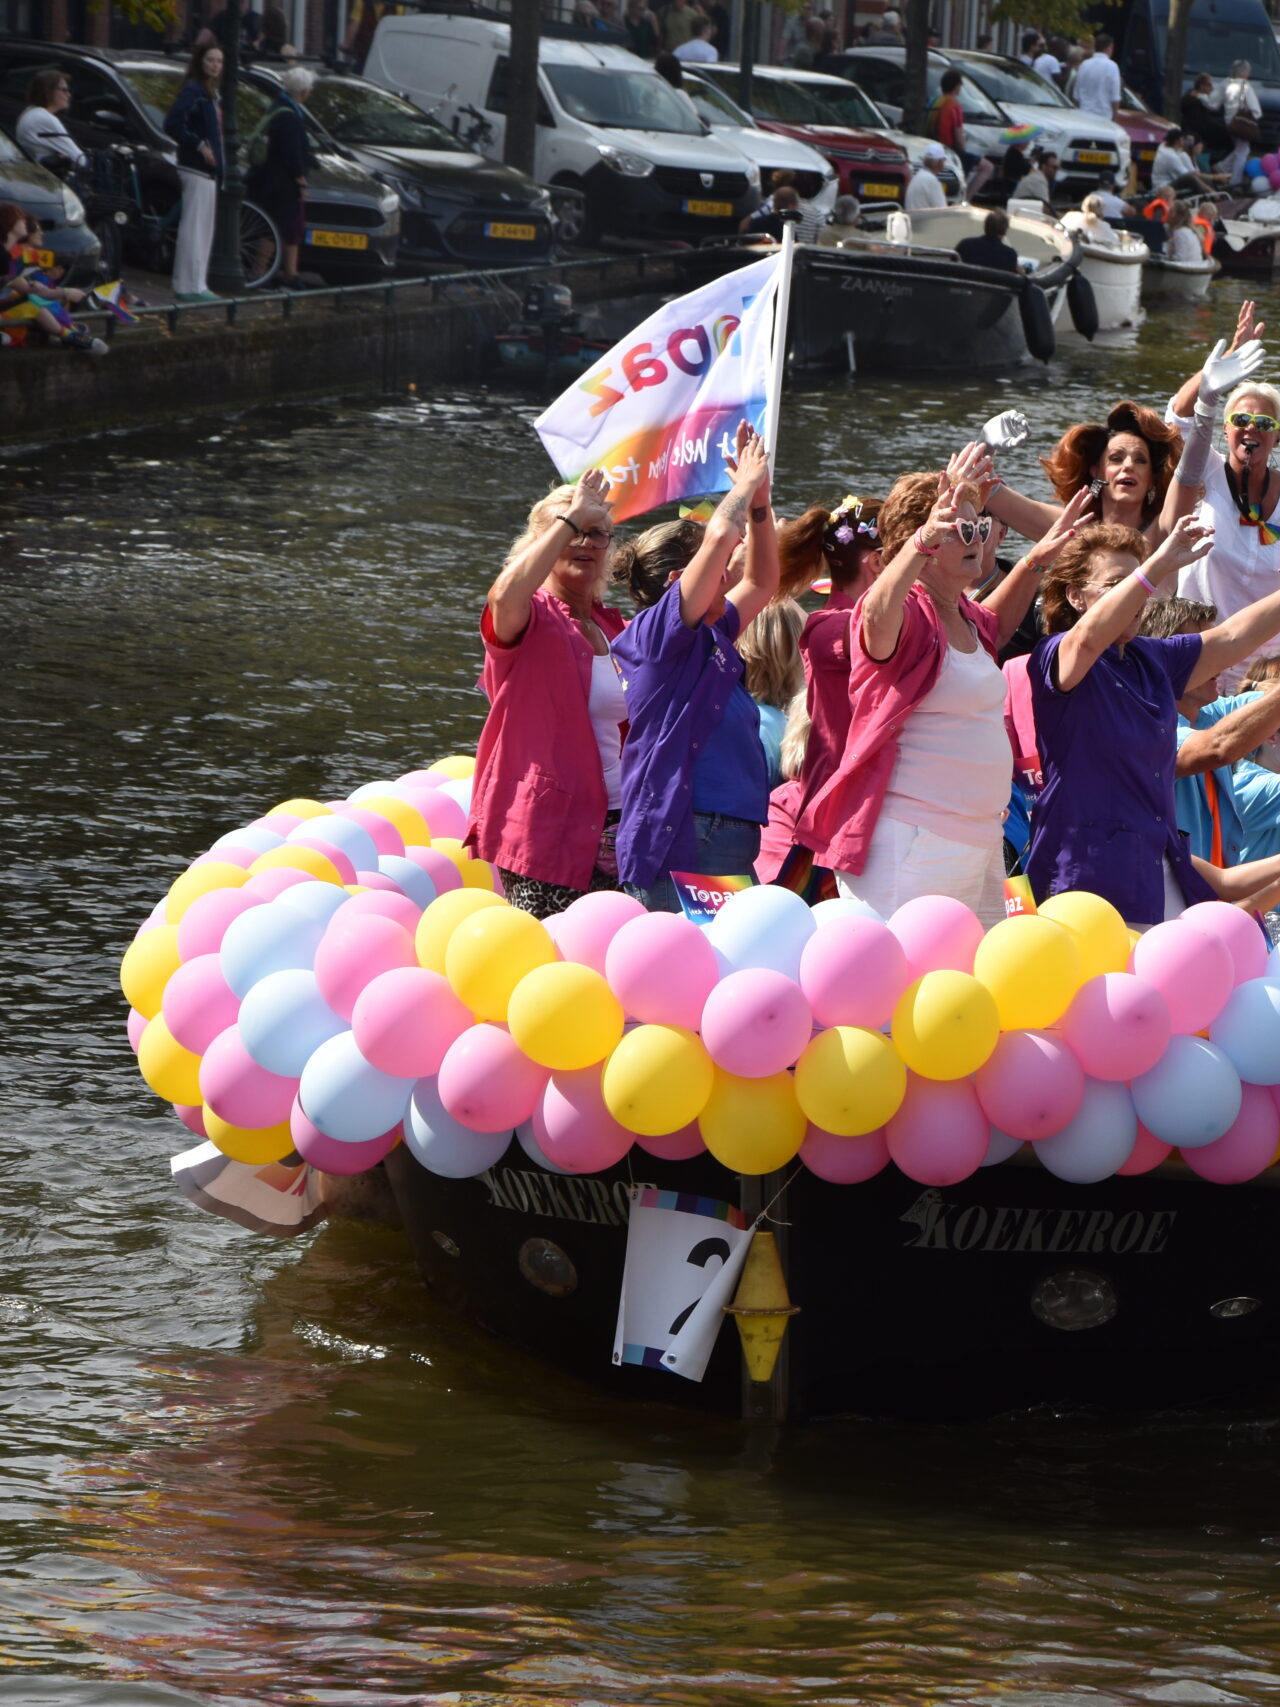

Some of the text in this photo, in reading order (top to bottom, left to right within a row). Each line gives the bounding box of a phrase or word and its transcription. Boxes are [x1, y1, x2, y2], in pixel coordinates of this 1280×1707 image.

[840, 275, 913, 297] ZAANdam
[684, 884, 738, 907] Topa
[903, 1202, 1178, 1254] KOEKEROE
